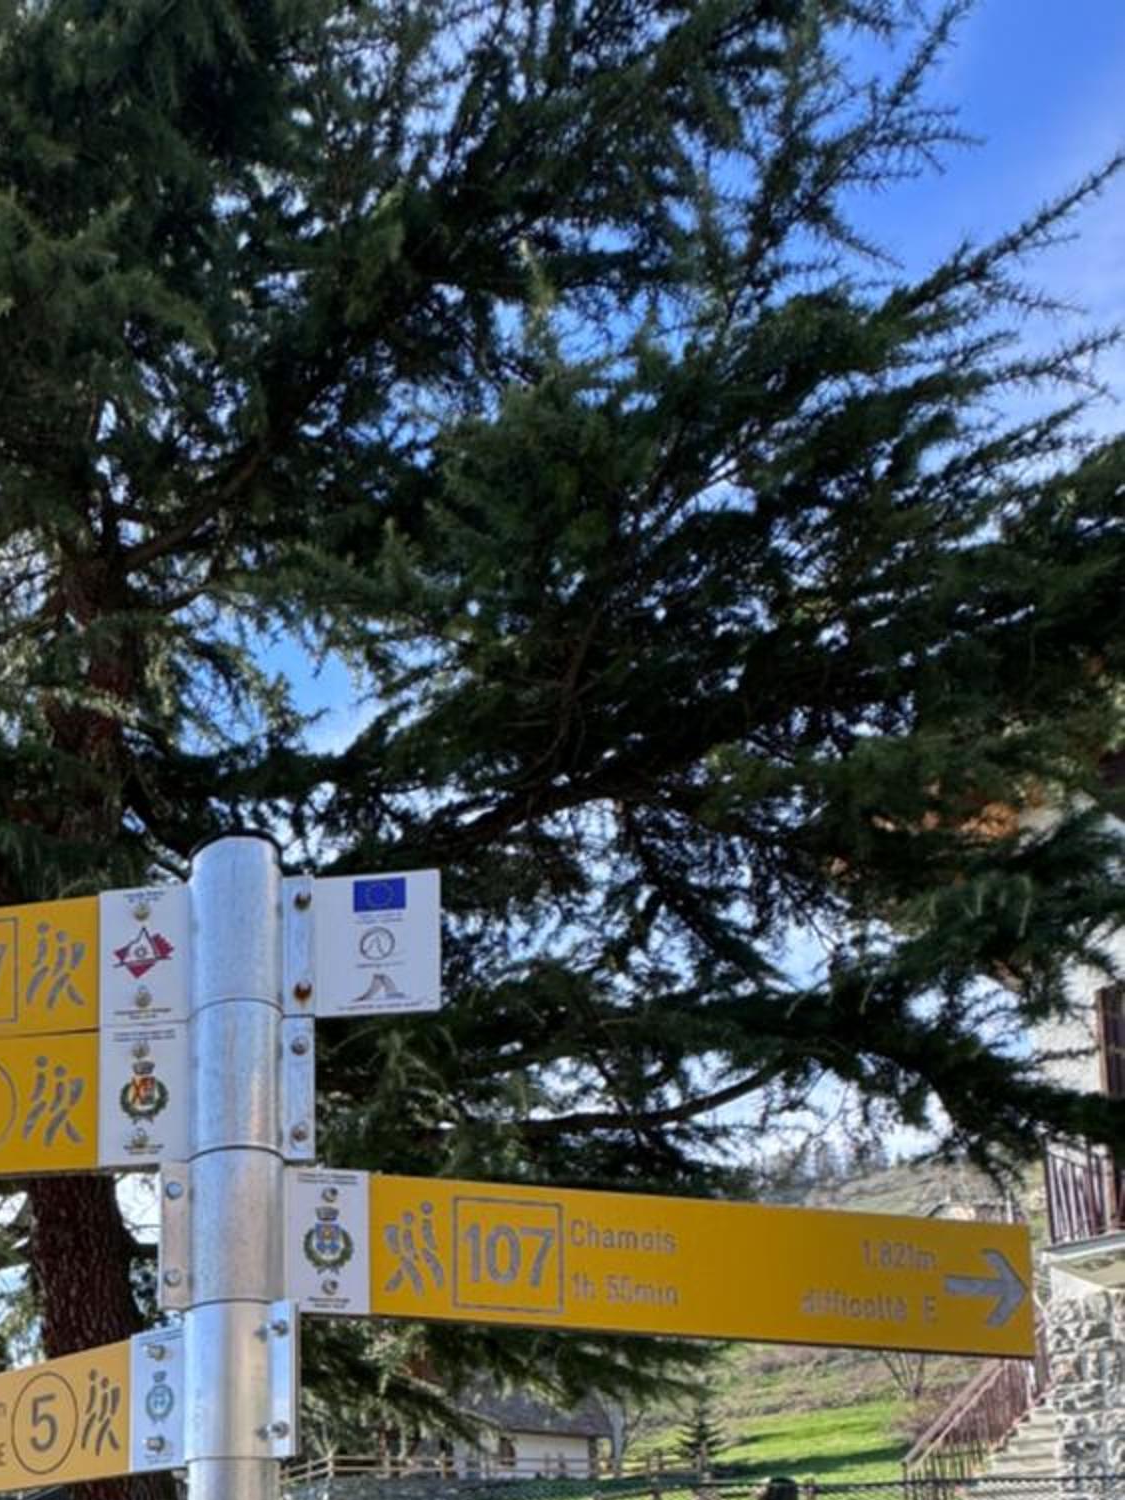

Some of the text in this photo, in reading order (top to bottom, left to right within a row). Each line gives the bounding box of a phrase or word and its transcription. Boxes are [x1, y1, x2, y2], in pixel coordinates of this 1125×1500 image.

[464, 1222, 555, 1288] 107
[570, 1218, 677, 1254] Chamois
[922, 1295, 939, 1324] E
[30, 1393, 59, 1453] 5
